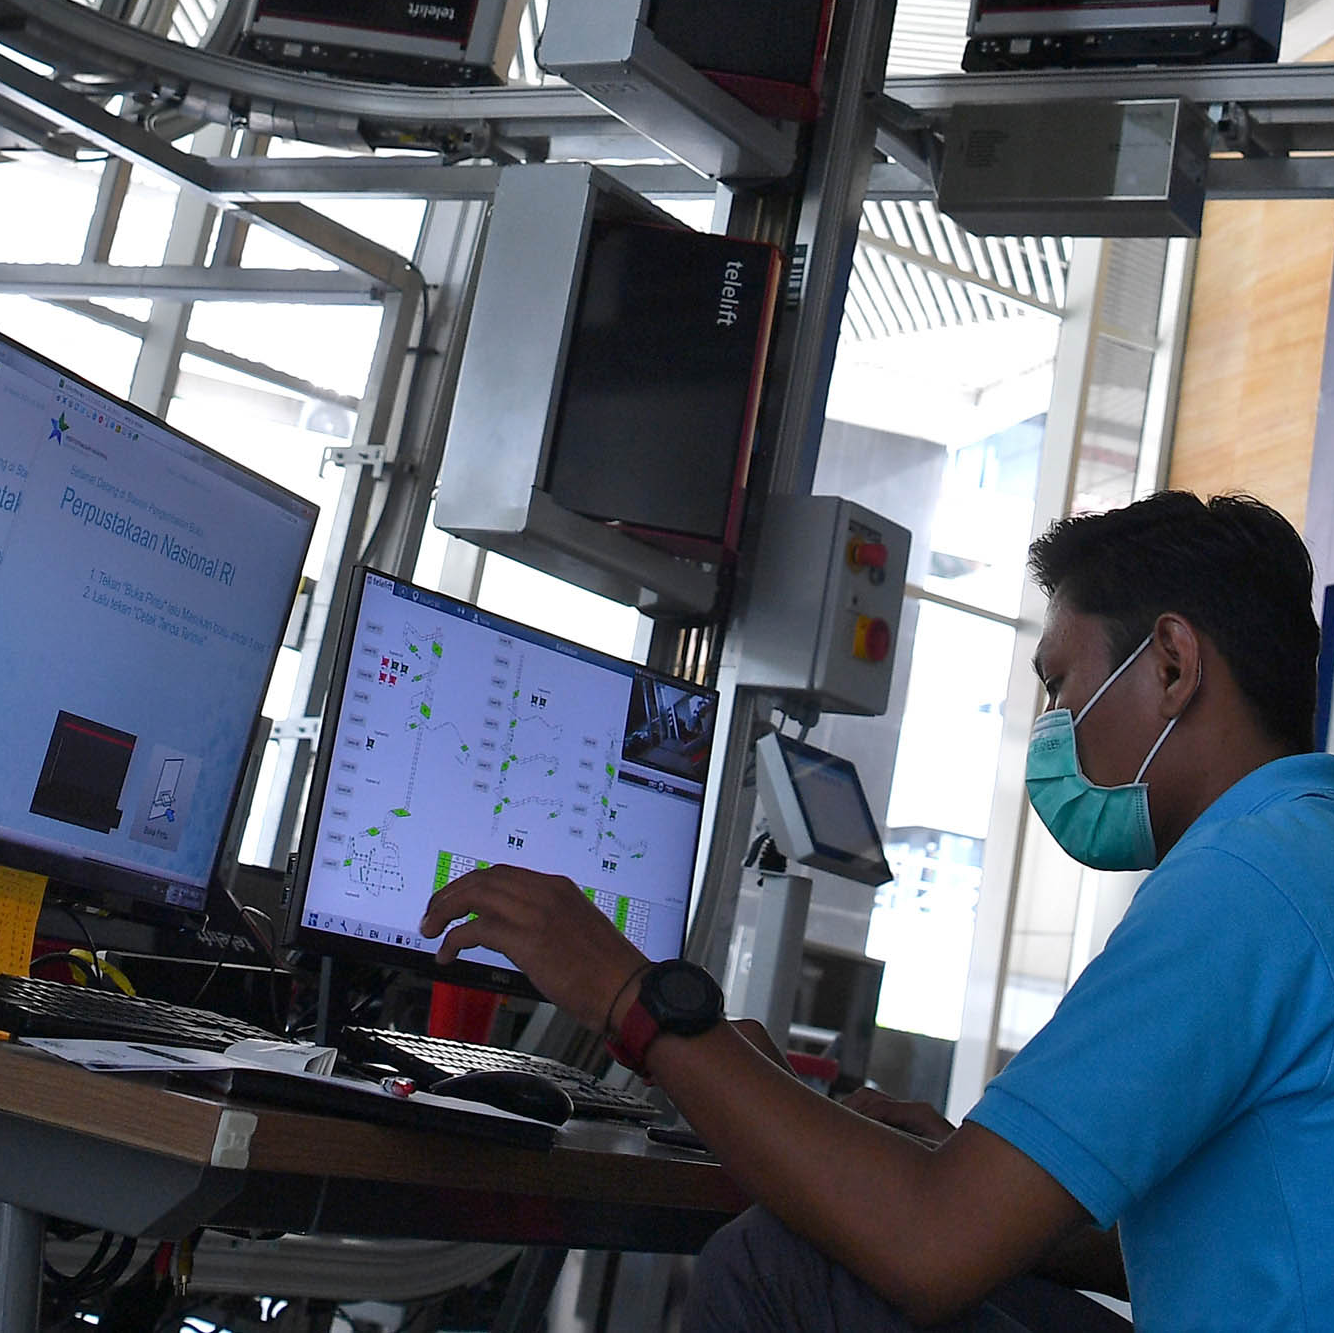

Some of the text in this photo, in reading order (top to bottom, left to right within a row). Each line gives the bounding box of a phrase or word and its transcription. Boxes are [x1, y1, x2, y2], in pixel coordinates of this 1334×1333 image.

[408, 1, 455, 21] telelift
[716, 260, 745, 326] telelift
[60, 486, 236, 587] Perpustakaan Nasional RI
[369, 929, 379, 940] EN
